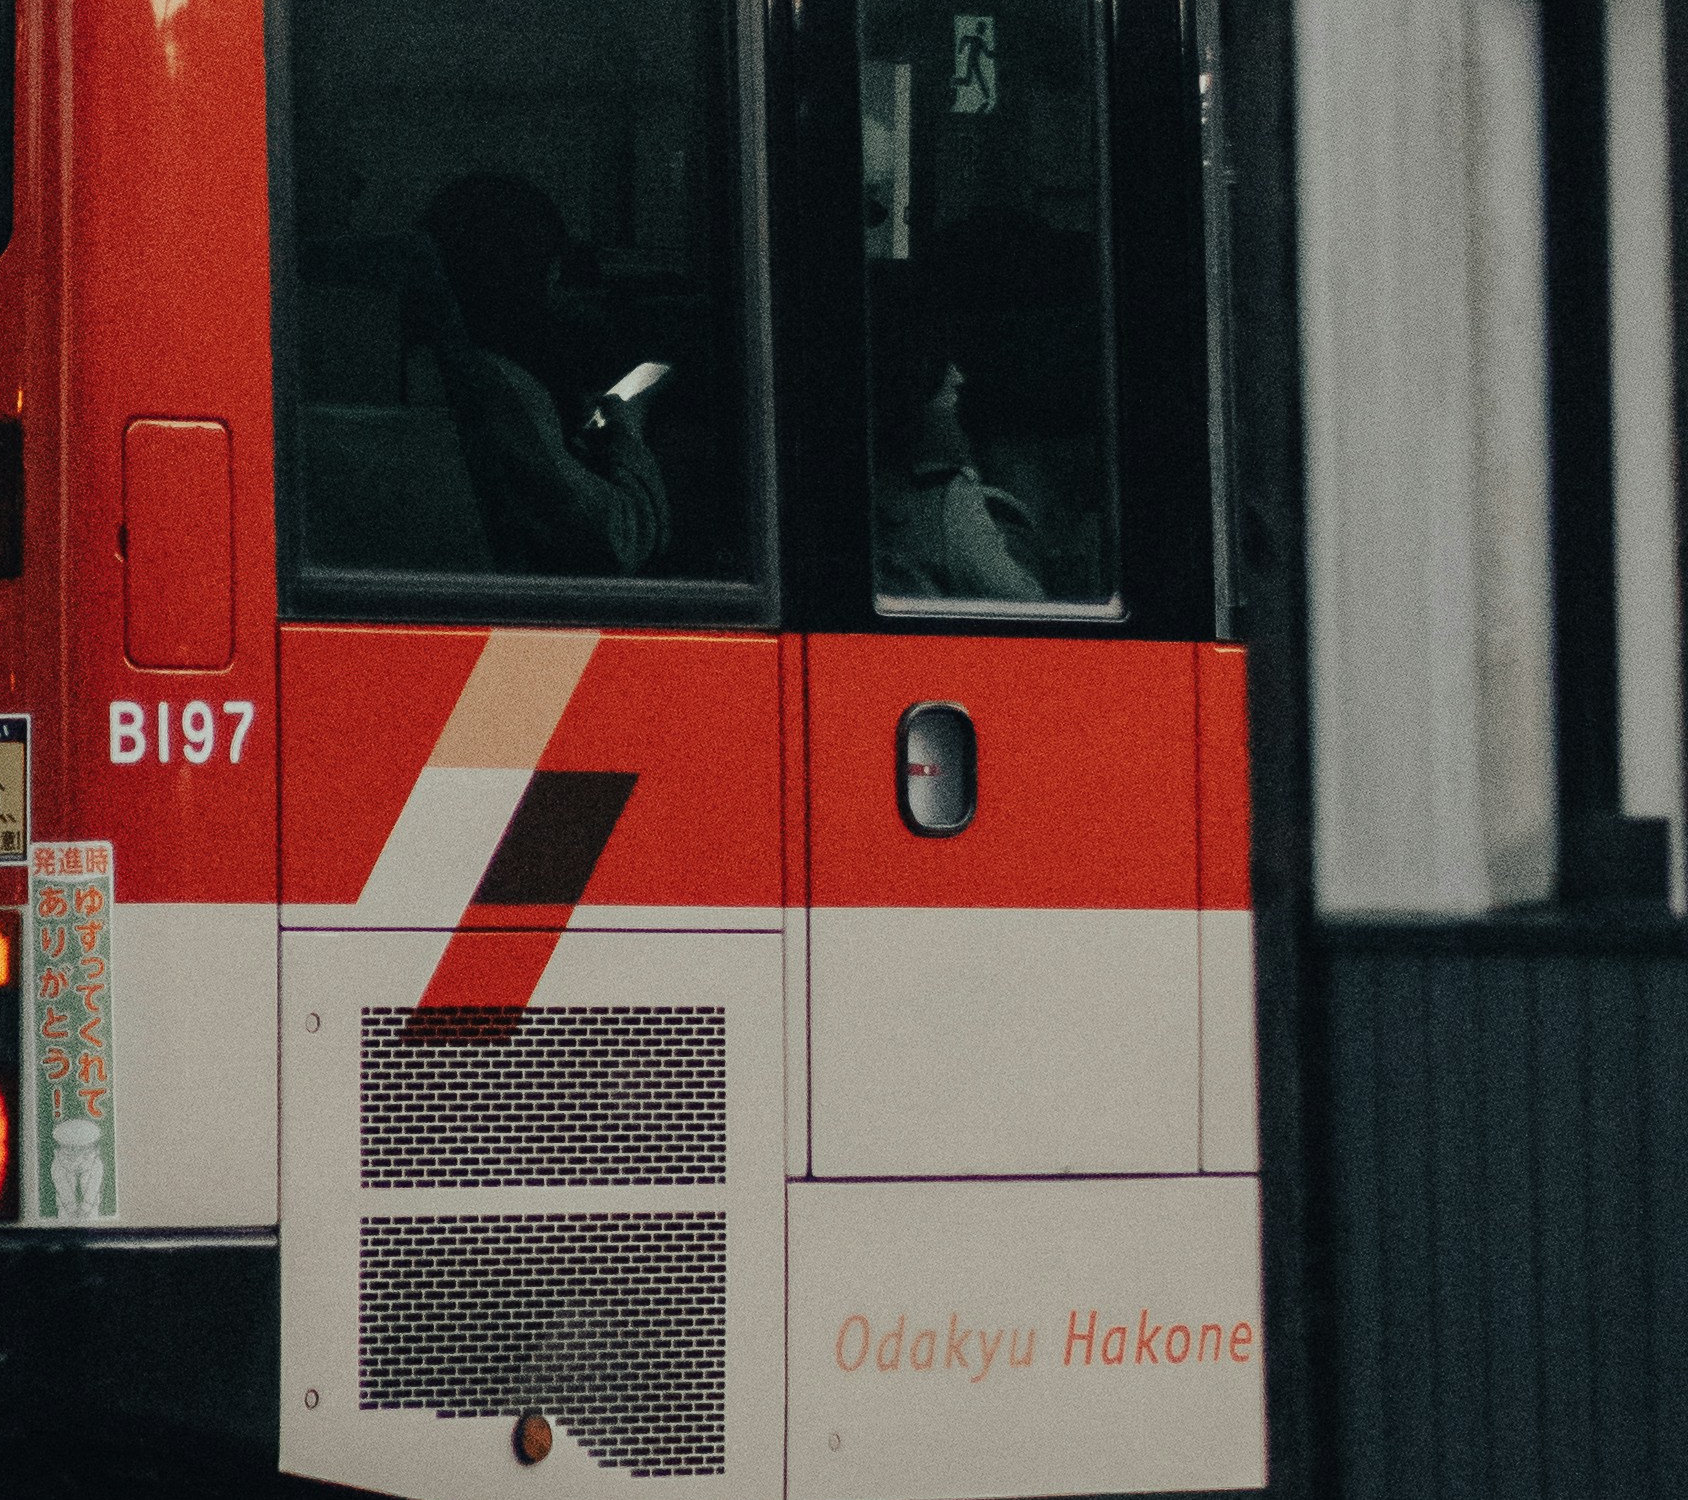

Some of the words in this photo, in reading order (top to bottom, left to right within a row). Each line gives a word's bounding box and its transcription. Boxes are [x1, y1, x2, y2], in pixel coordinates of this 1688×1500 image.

[110, 701, 254, 764] B197
[33, 846, 109, 876] 発進時
[834, 1312, 1037, 1384] Odakyu
[1062, 1308, 1254, 1367] Hakone
